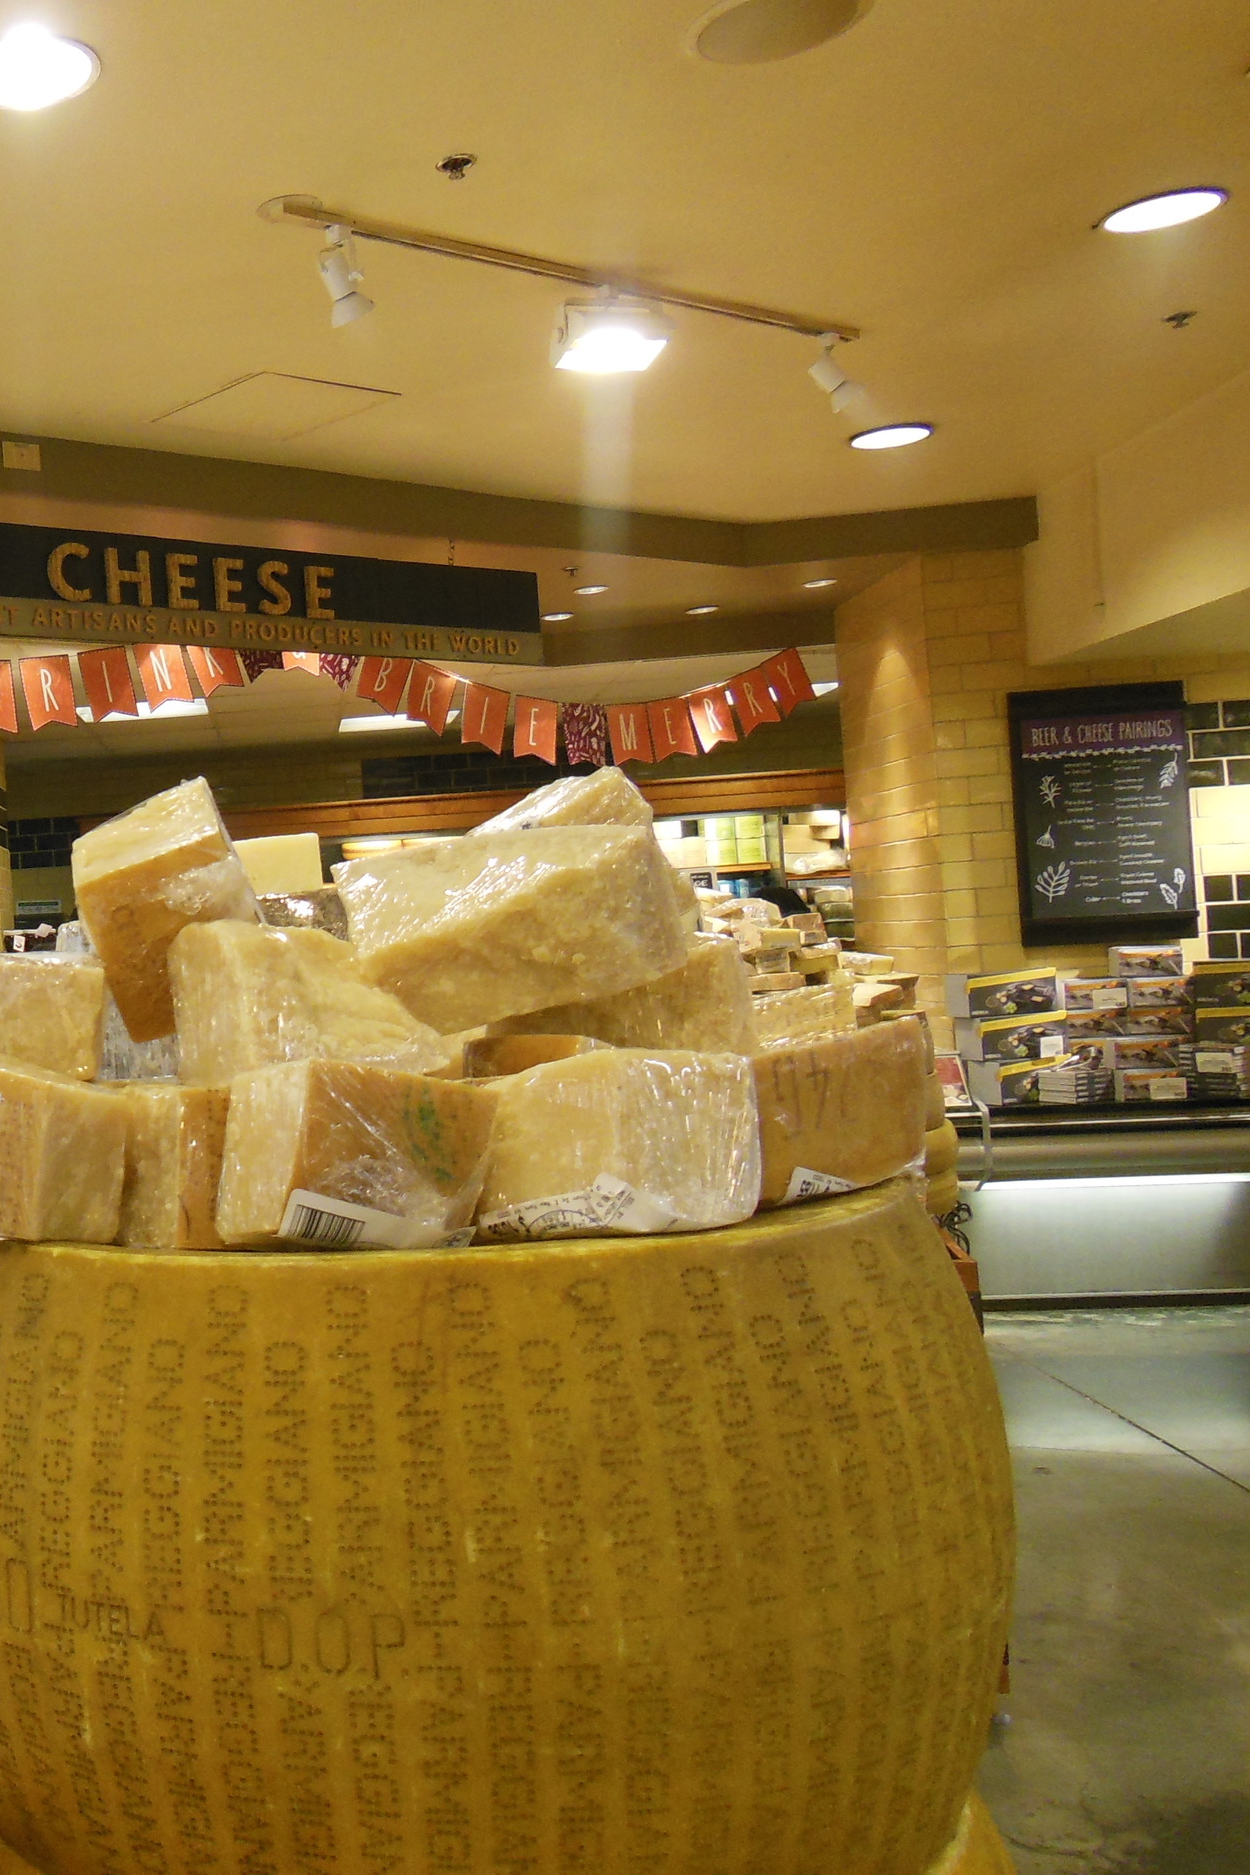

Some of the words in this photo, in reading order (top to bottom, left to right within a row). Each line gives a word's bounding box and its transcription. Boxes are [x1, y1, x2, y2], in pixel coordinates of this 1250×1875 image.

[46, 541, 336, 620] CHEESE
[32, 606, 157, 635] ARTISANS
[167, 615, 217, 638] AND
[230, 618, 364, 648] PRODUCERS
[370, 630, 394, 649] IN
[403, 631, 442, 652] THE
[451, 634, 520, 657] WORLD
[372, 657, 540, 747] BRIE
[618, 662, 801, 751] MERRY
[1031, 727, 1059, 747] BEER
[1063, 726, 1073, 744] &
[1077, 722, 1114, 744] CHEESE
[1119, 719, 1173, 740] PAIRINGS
[58, 1592, 166, 1641] TUTELA
